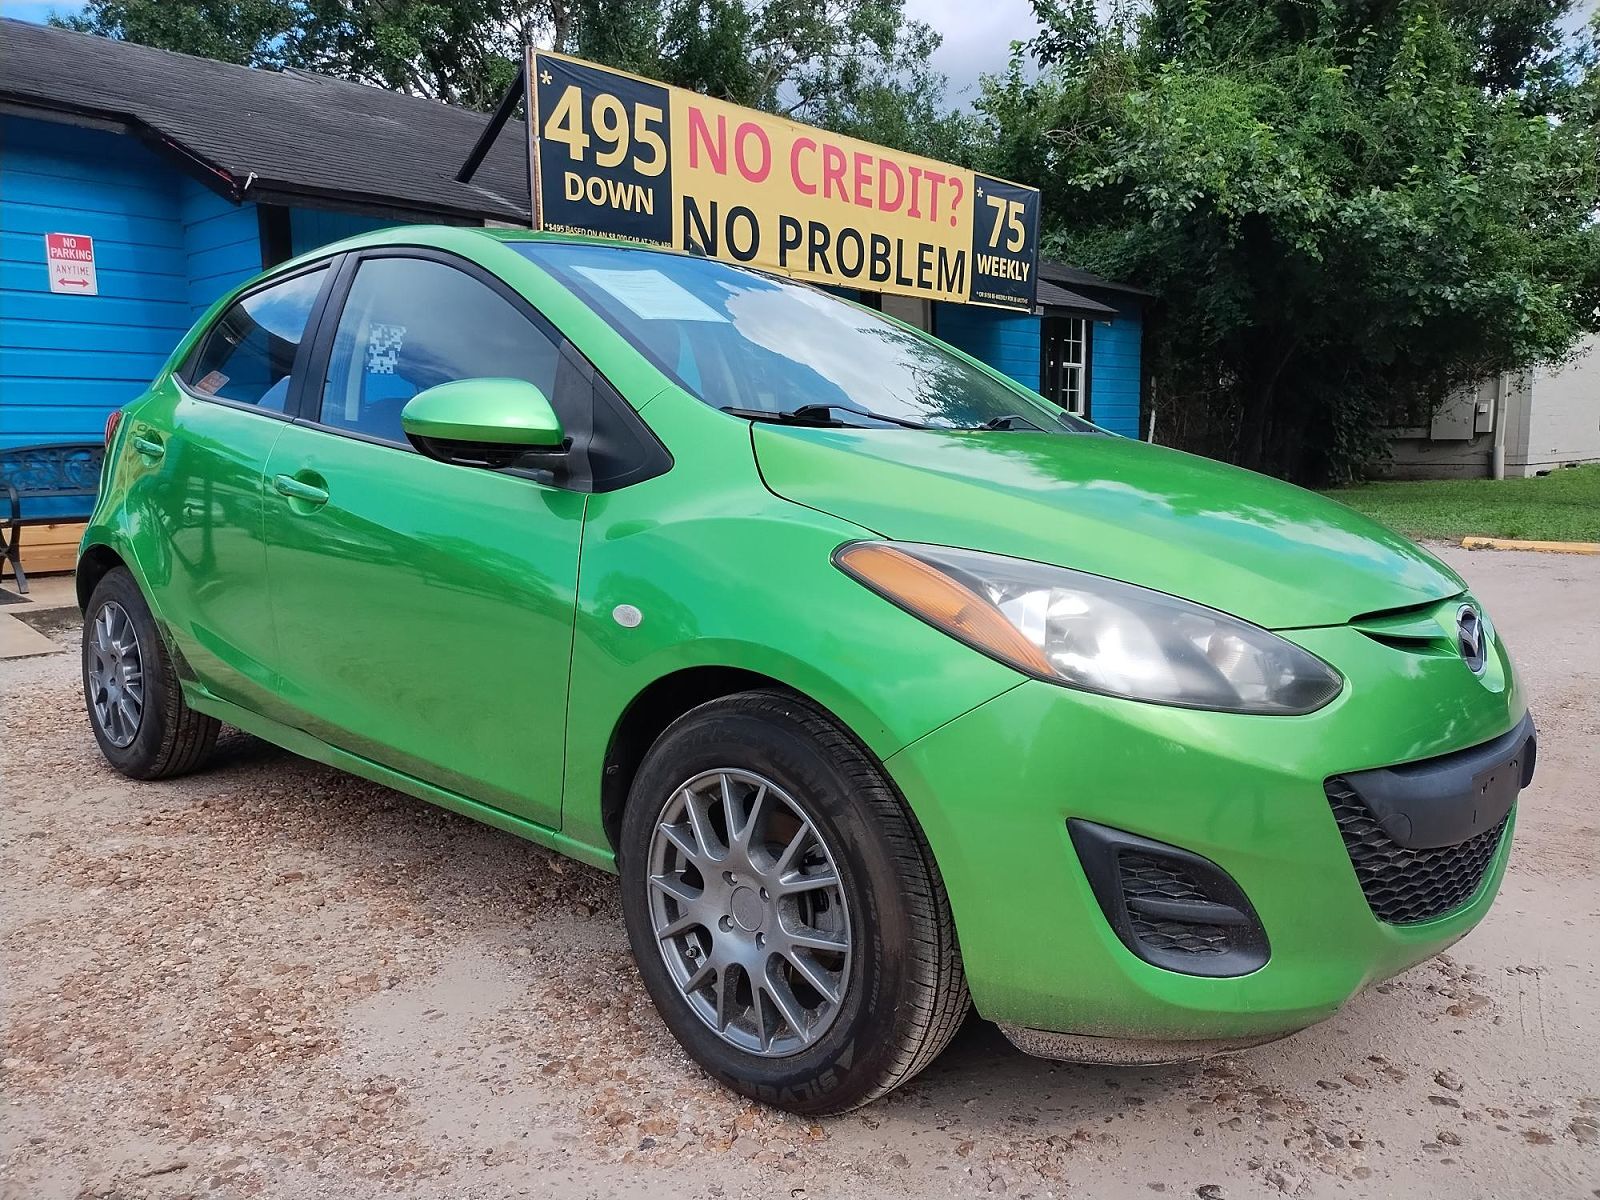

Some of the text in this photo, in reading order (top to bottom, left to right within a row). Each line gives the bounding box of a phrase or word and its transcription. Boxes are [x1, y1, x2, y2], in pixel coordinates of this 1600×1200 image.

[544, 85, 667, 177] 495
[688, 106, 964, 228] NO CREDIT?
[564, 171, 654, 215] DOWN
[63, 237, 77, 249] NO
[683, 194, 966, 295] NO PROBLEM
[986, 195, 1026, 253] 75
[50, 247, 92, 261] PARKING
[56, 264, 90, 276] ANYTIME
[977, 253, 1030, 282] WEEKLY
